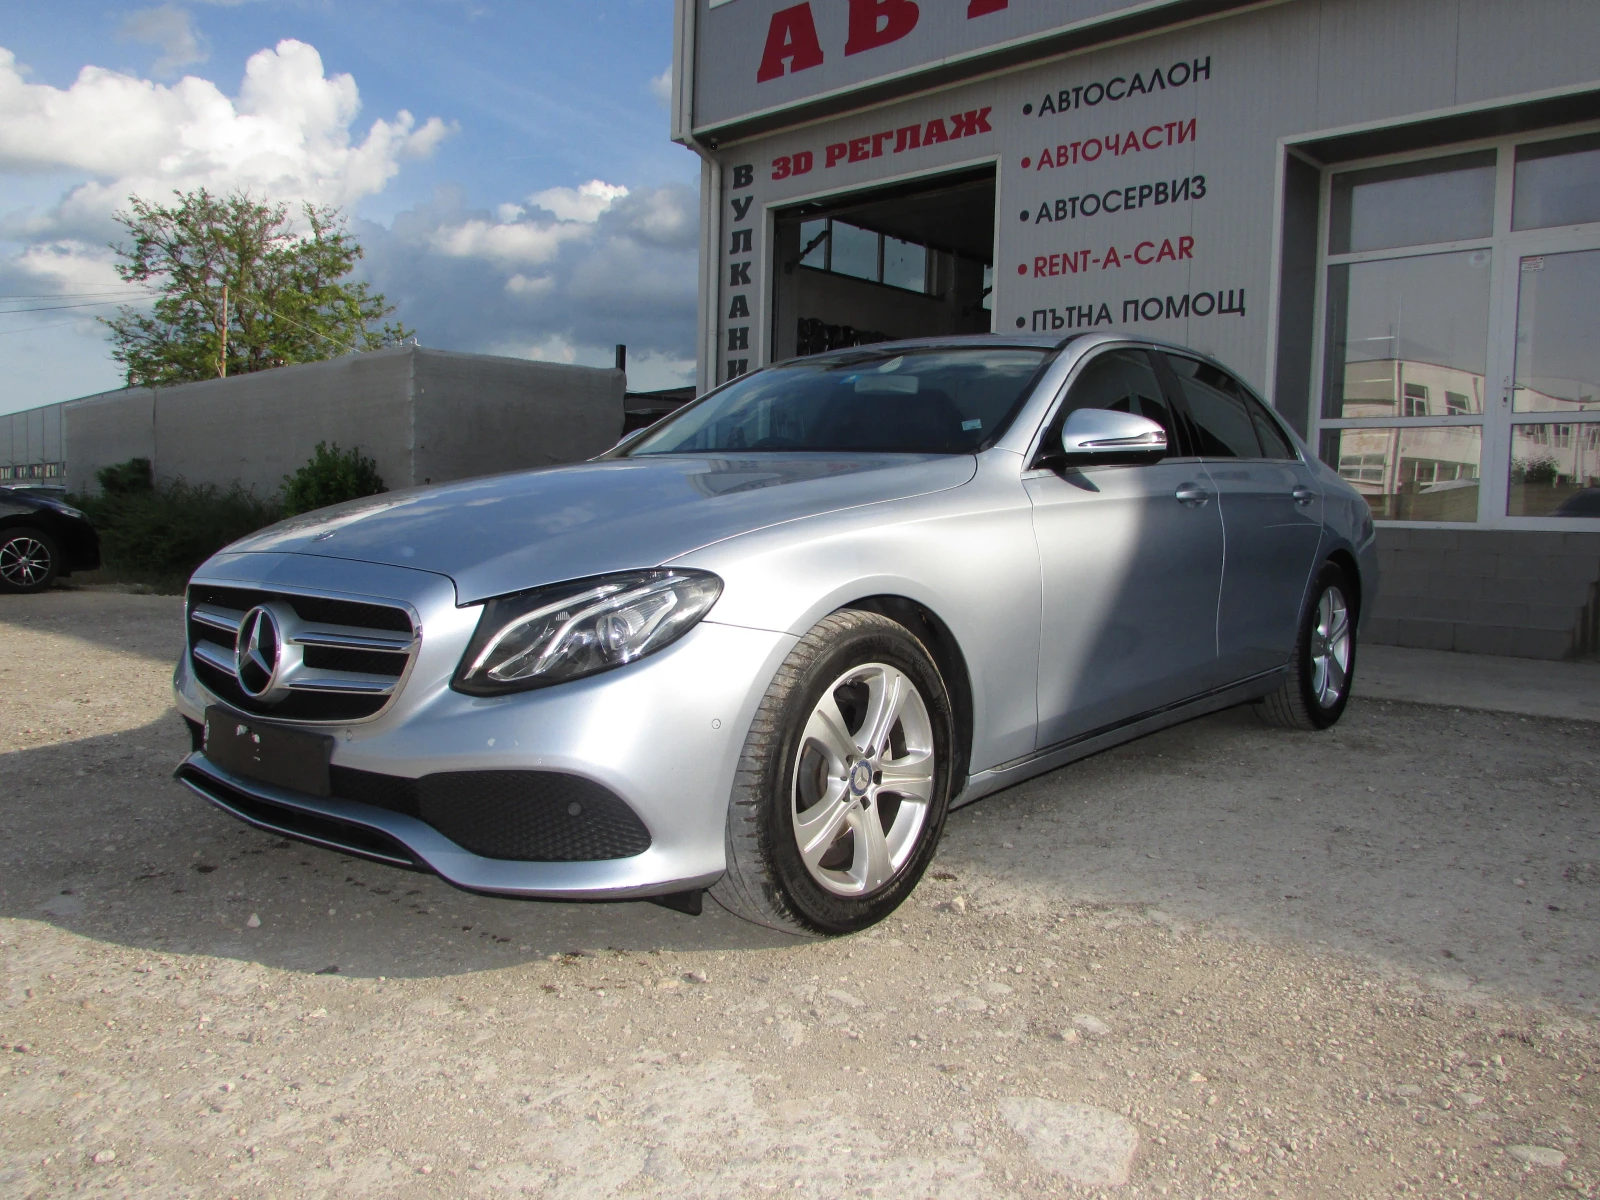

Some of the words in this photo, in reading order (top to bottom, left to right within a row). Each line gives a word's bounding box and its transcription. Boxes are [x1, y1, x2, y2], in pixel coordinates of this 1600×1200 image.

[757, 0, 1009, 83] АВ
[1037, 55, 1211, 118] АВТОСАЛОН
[771, 151, 814, 181] 3D
[825, 107, 993, 169] РЕГЛАЖ
[1036, 118, 1197, 171] АВТОЧАСТИ
[1035, 175, 1207, 225] АВТОСЕРВИЗ
[1033, 235, 1195, 278] RENT-A-CAR
[1031, 302, 1113, 332] ПЪТНА
[1122, 288, 1246, 323] ПОМОЩ
